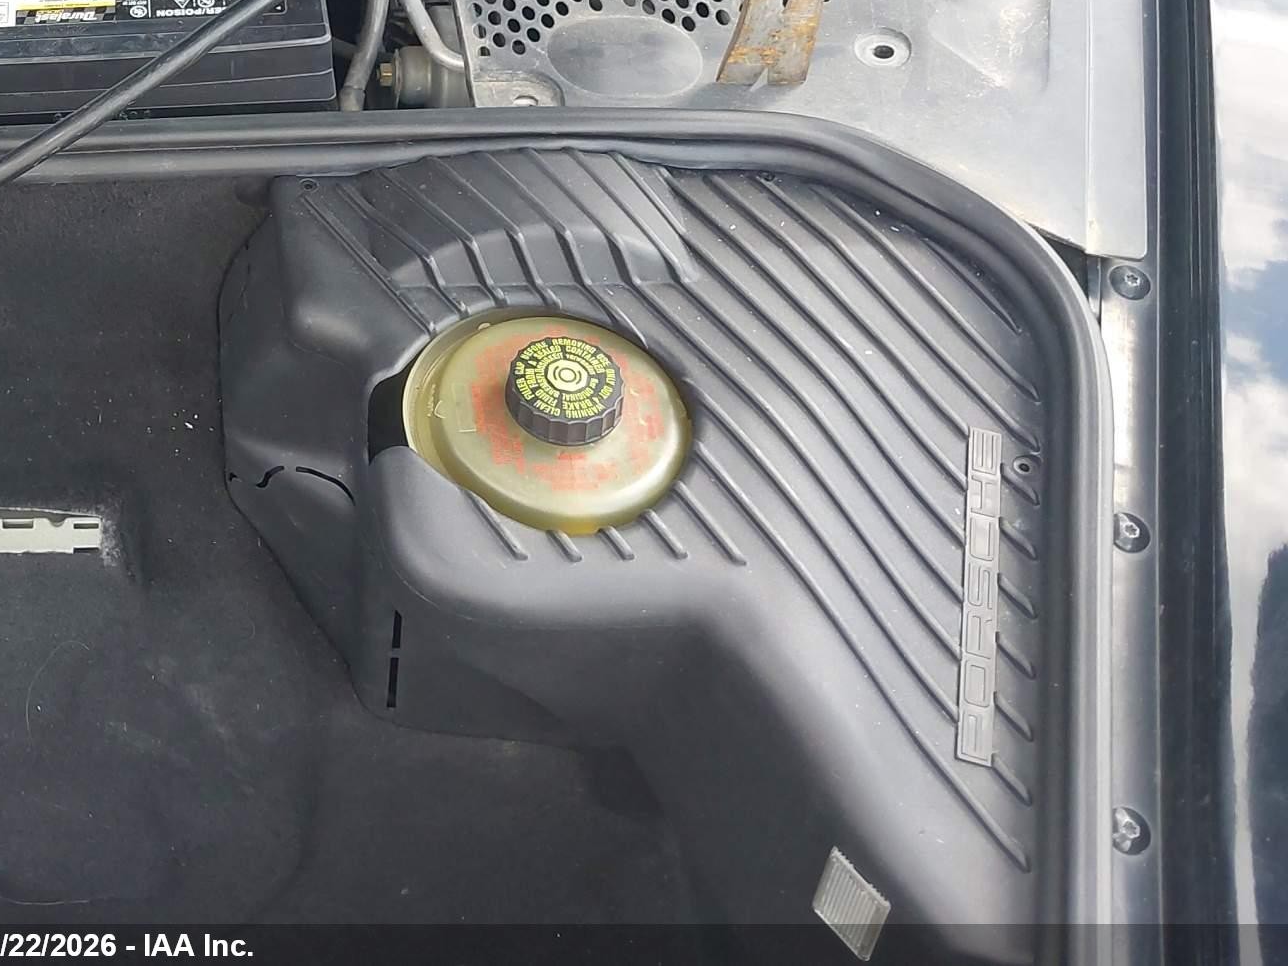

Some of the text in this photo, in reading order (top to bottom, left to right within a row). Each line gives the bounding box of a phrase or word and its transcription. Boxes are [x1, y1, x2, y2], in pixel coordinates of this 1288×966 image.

[34, 10, 98, 23] Duralast
[515, 338, 596, 416] CLEAN FILLER CAP BEFORE REMOVING
[563, 399, 593, 410] BRAKE
[566, 402, 605, 418] WARNING
[961, 432, 999, 760] PORSCHE
